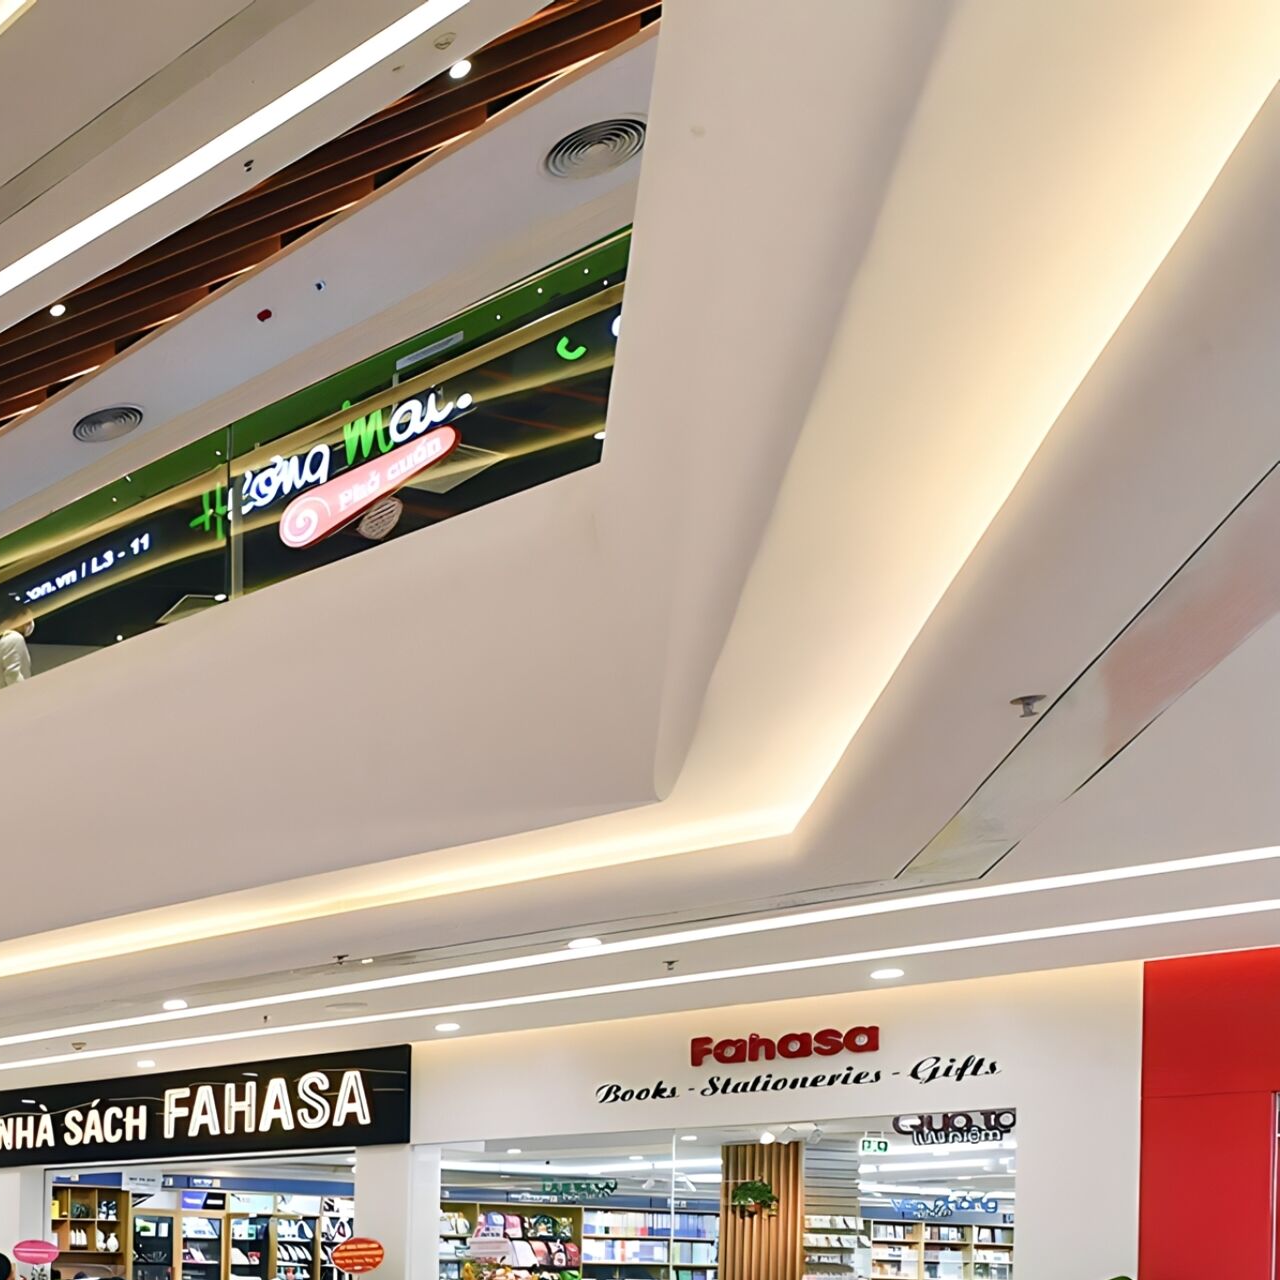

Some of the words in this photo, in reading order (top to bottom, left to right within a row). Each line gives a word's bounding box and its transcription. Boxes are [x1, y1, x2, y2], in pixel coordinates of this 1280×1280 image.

[130, 533, 151, 555] 11
[690, 1025, 880, 1067] Fahasa
[595, 1080, 680, 1104] Books
[700, 1065, 882, 1097] Stationeries
[907, 1054, 1003, 1085] Gifts
[63, 1098, 148, 1147] SÁCH
[163, 1070, 371, 1139] FAHASA
